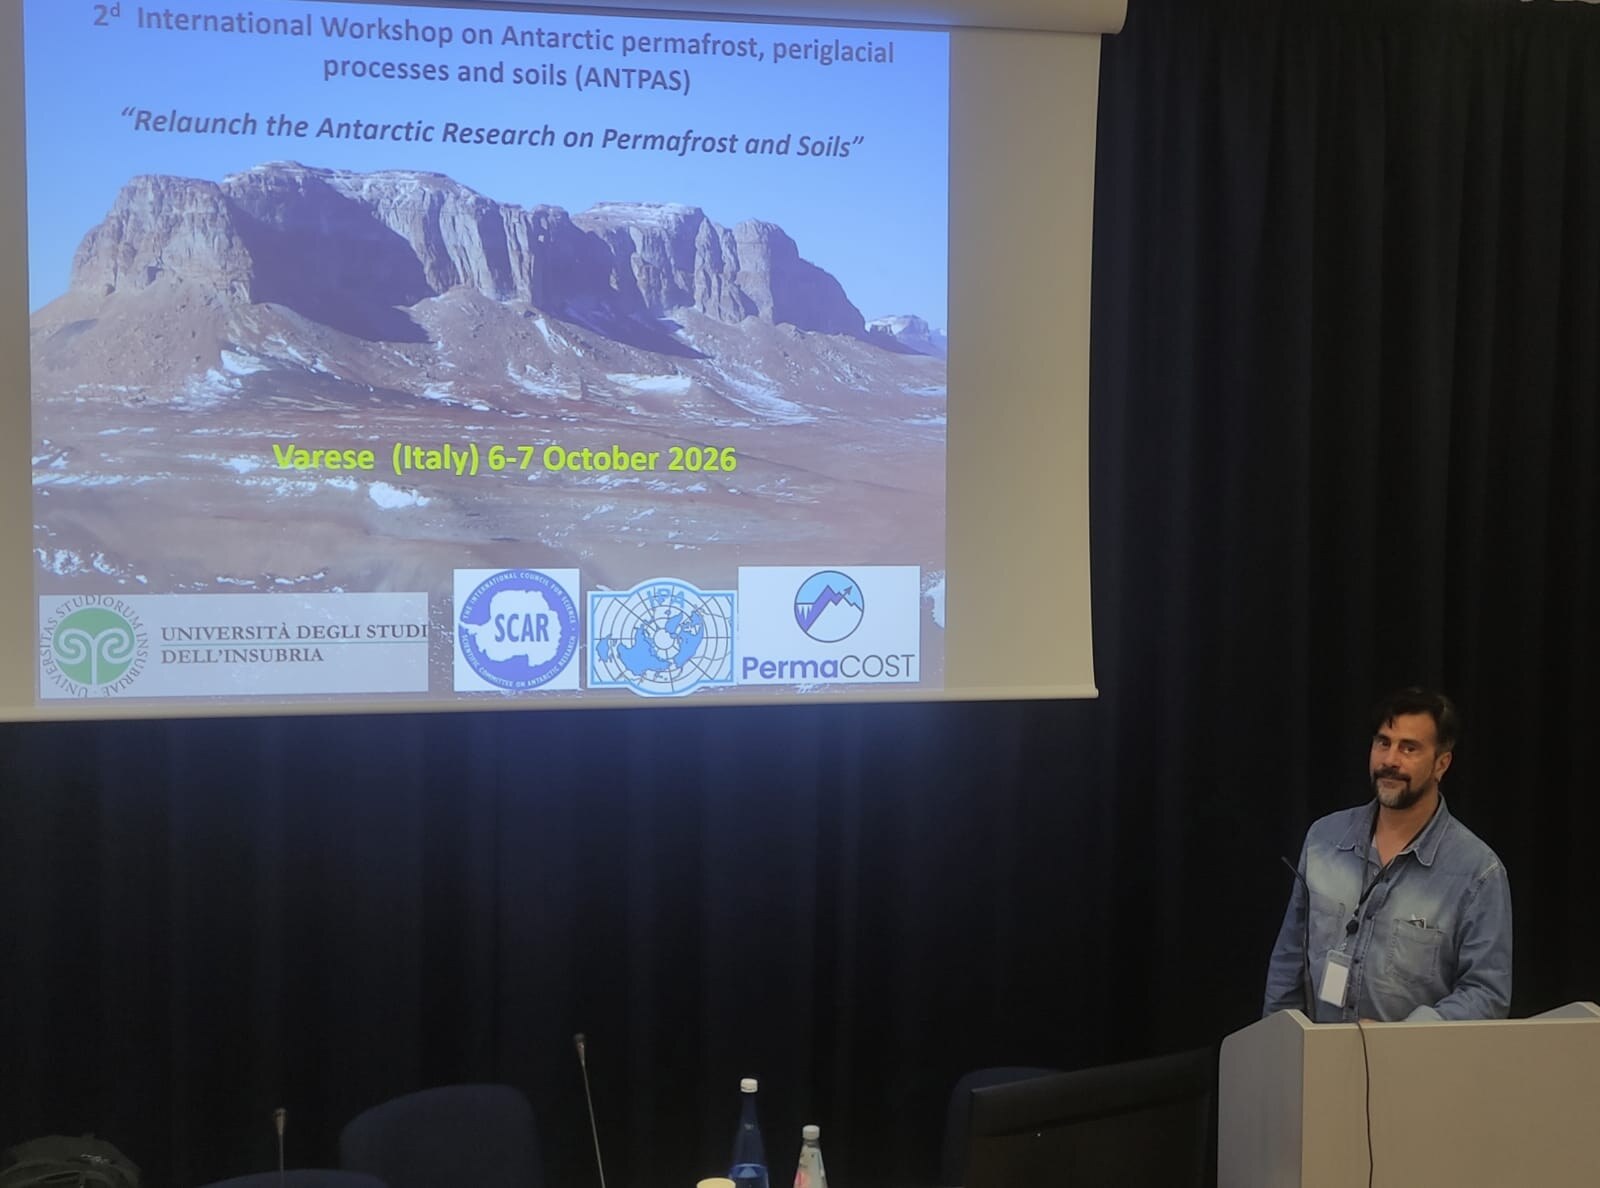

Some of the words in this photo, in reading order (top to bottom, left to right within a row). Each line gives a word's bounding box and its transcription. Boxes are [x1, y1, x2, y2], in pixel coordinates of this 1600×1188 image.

[137, 7, 312, 37] International
[320, 16, 453, 48] Workshop
[462, 26, 493, 44] on
[501, 25, 614, 51] Antarctic
[622, 33, 765, 62] permafrost,
[773, 39, 895, 65] periglacial
[323, 56, 450, 82] processes
[458, 62, 503, 83] and
[513, 64, 567, 87] soils
[575, 65, 691, 95] (ANTPAS)
[121, 106, 257, 136] “Relaunch
[266, 113, 309, 138] the
[316, 117, 434, 143] Antarctic
[442, 122, 555, 148] Research
[563, 130, 594, 148] on
[601, 129, 738, 156] Permafrost
[745, 133, 790, 156] and
[797, 135, 865, 159] Soils”
[272, 444, 375, 470] Varese
[392, 443, 479, 475] (Italy)
[487, 446, 534, 470] 6-7
[543, 445, 659, 472] October
[668, 446, 737, 472] 2026
[56, 594, 144, 630] STUDIORUM
[495, 613, 549, 643] SCAR
[161, 622, 290, 641] UNIVERSITÀ
[296, 624, 361, 639] DEGLI
[367, 624, 428, 639] STUDI
[40, 616, 88, 698] UNIVERSITAS
[101, 632, 149, 697] INSUBRIAE
[161, 648, 324, 664] DELL’INSUBRIA
[742, 654, 915, 680] PermaCOST
